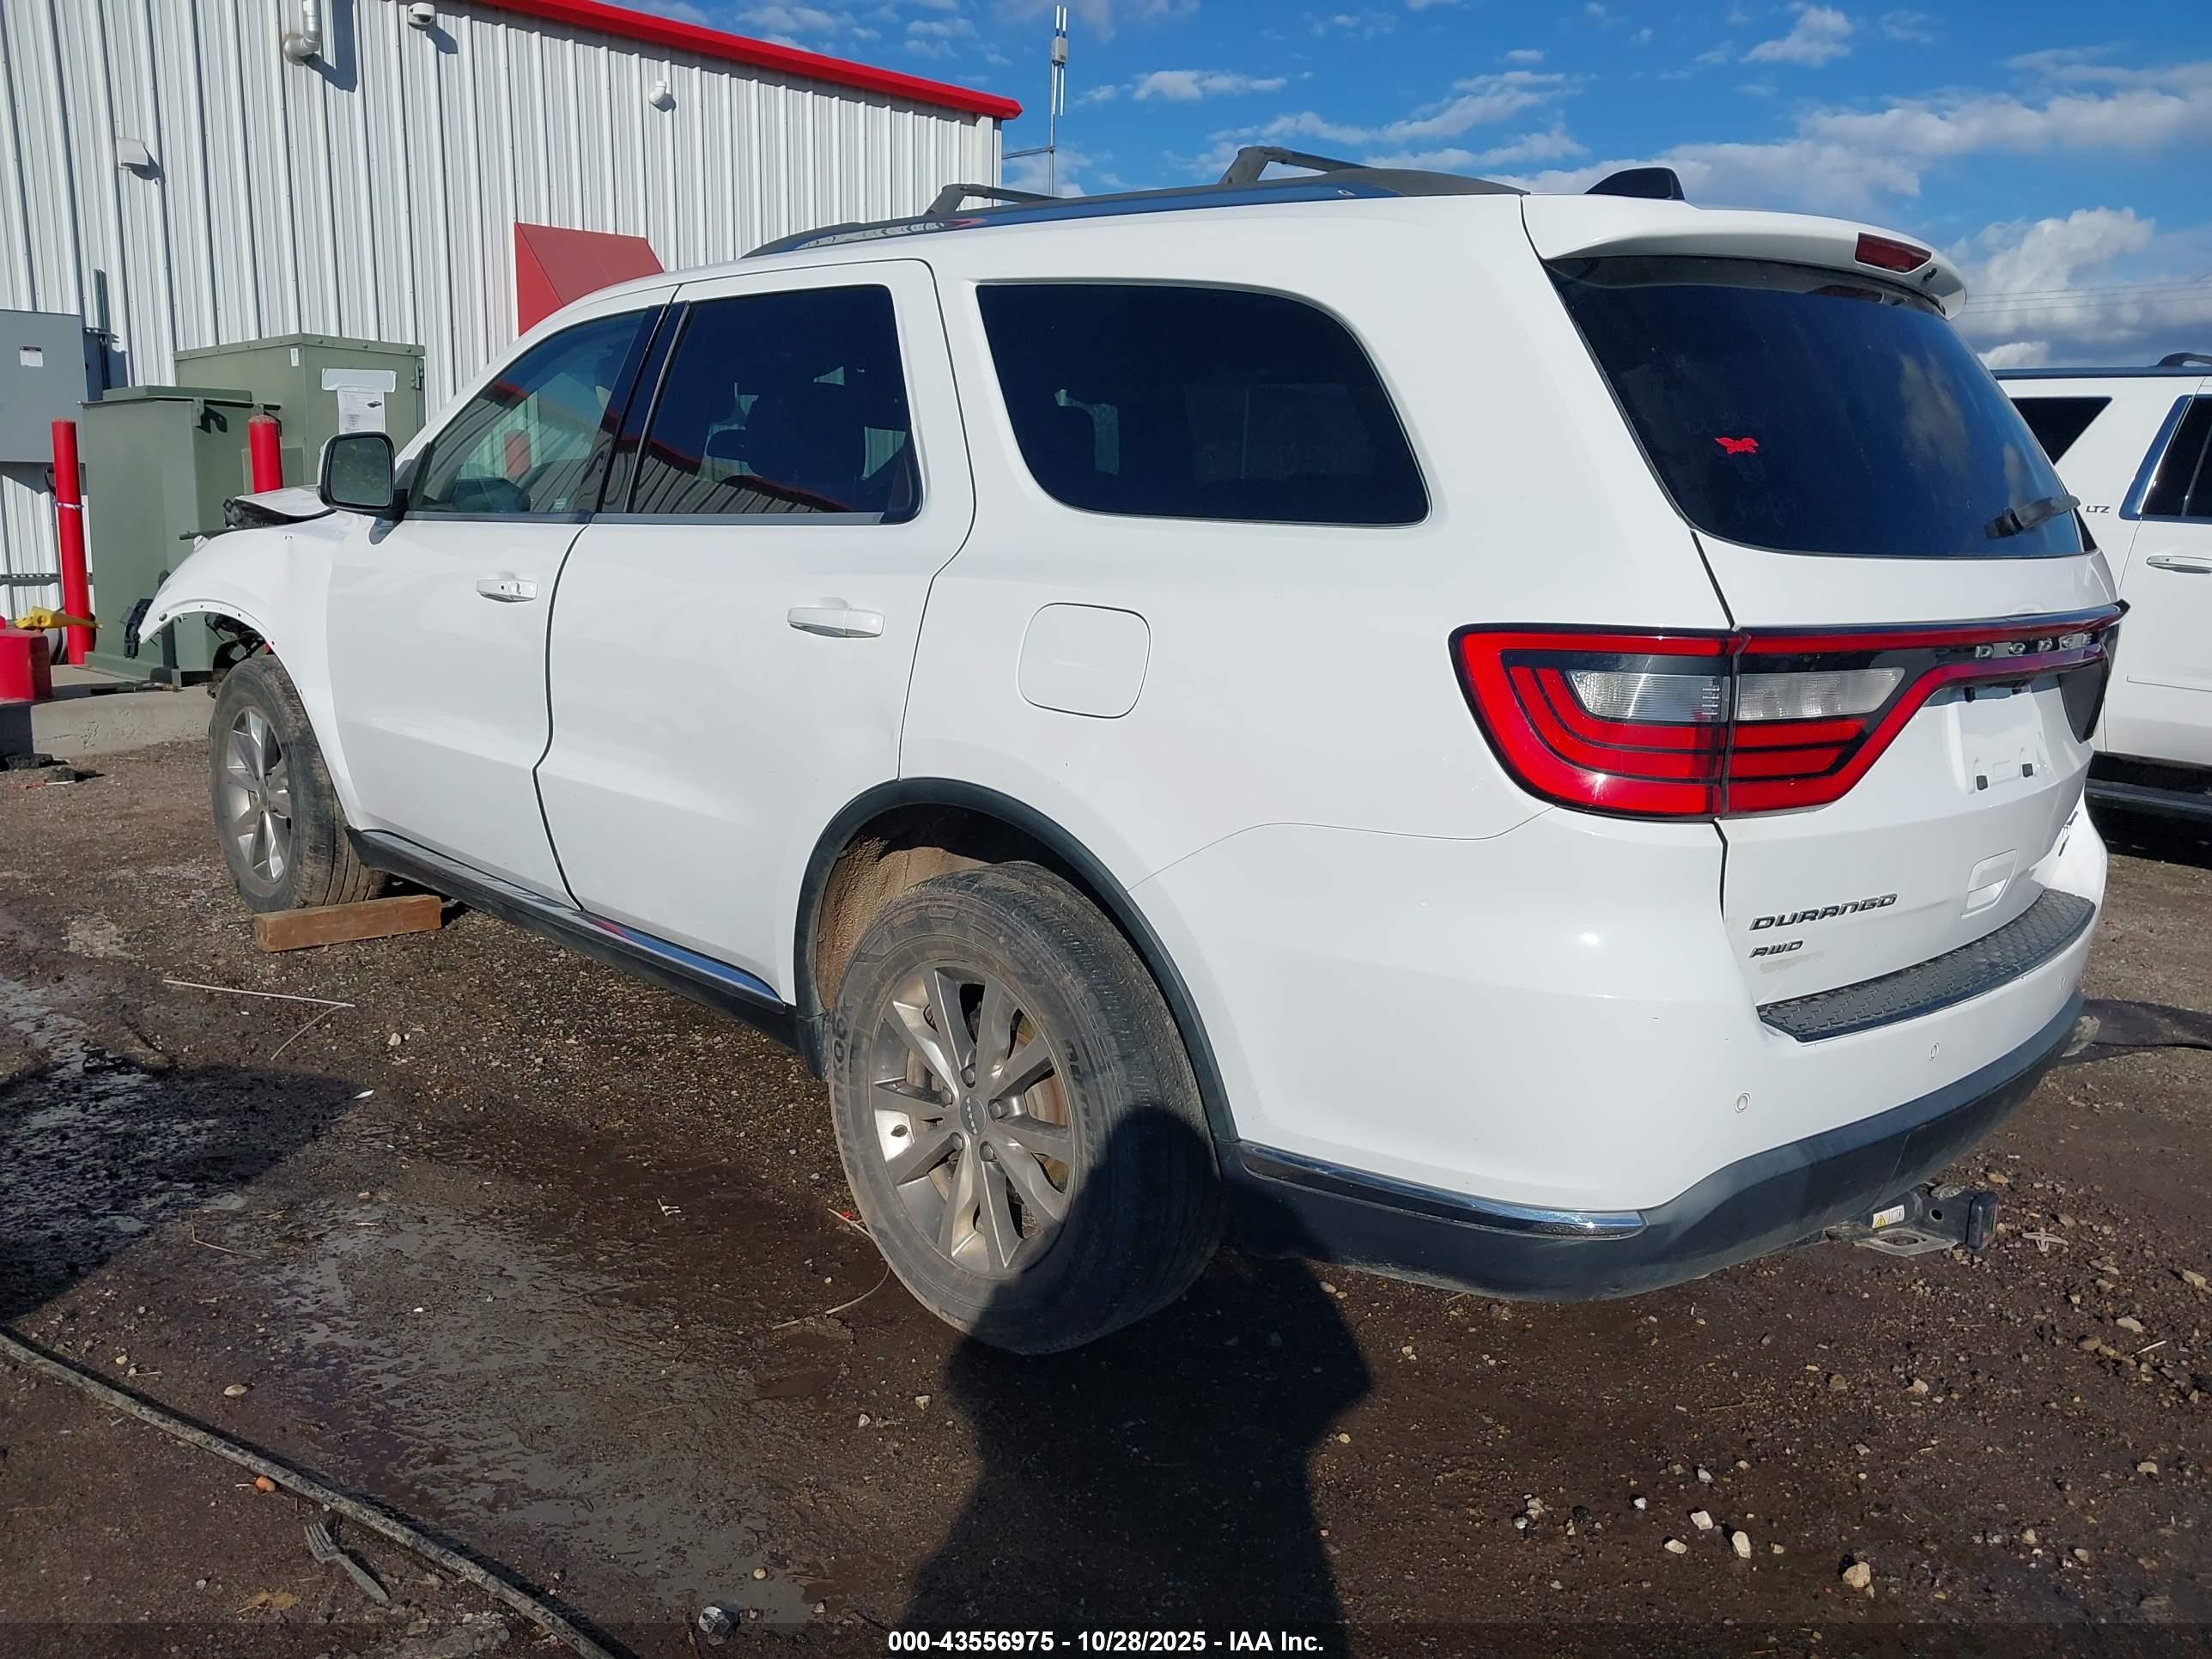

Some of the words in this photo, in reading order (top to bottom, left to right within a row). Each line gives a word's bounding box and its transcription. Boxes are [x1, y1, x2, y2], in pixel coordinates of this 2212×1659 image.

[2086, 505, 2111, 514] LTZ
[1749, 893, 1898, 931] DURANGO
[1749, 940, 1803, 958] AWD
